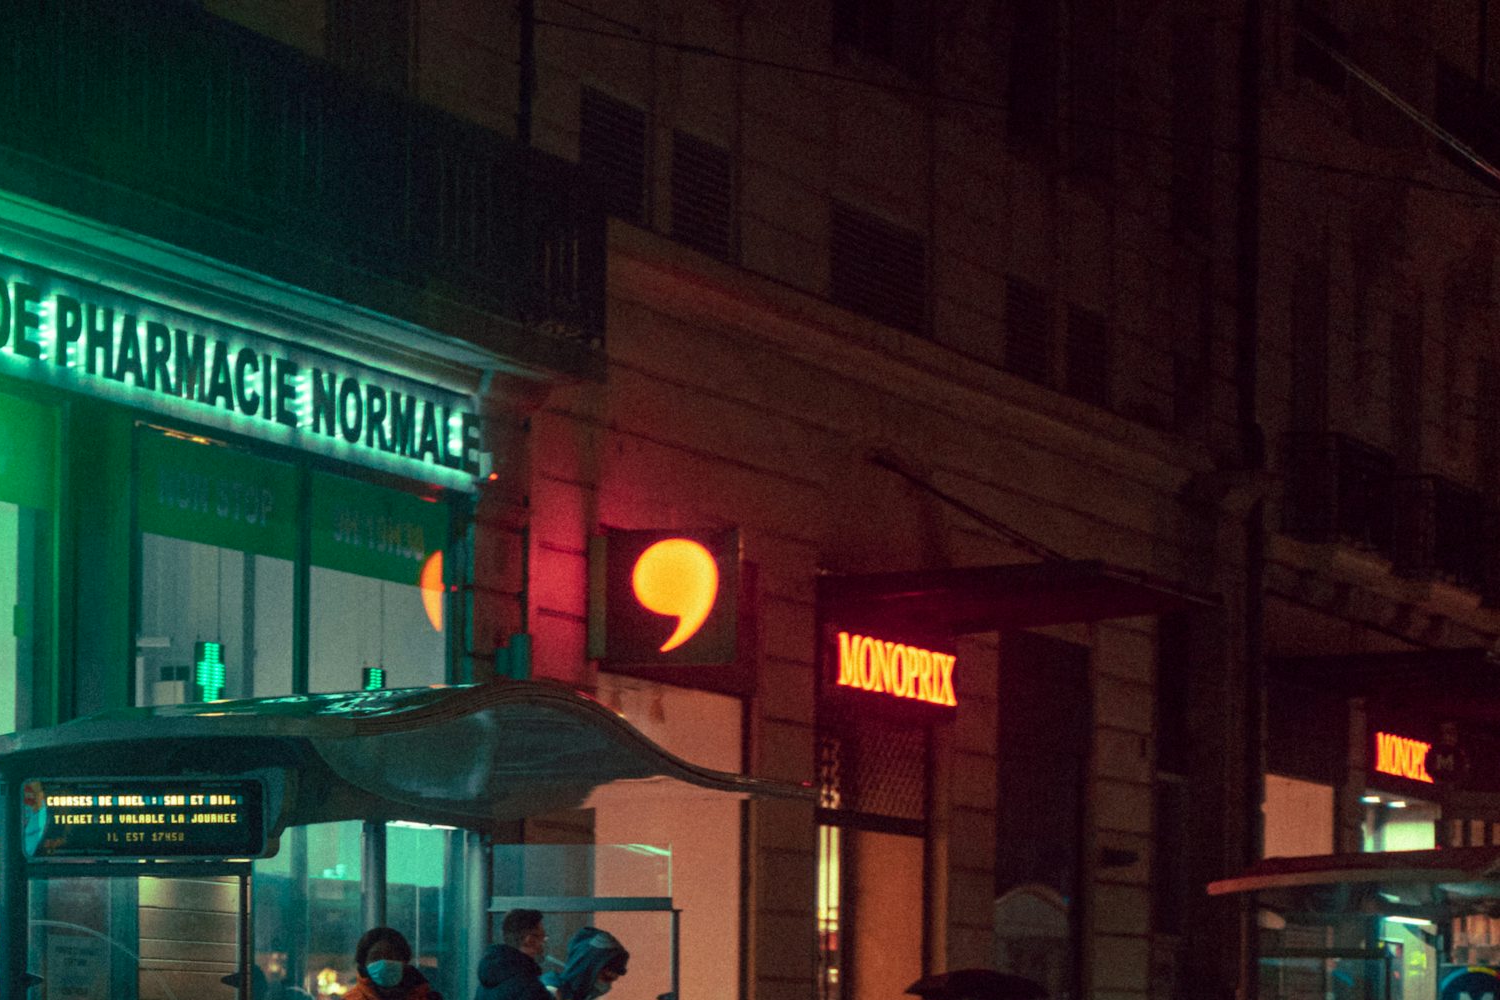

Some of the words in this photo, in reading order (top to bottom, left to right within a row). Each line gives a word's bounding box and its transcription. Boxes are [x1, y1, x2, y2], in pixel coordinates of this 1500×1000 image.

[55, 293, 299, 428] PHARMACIE
[311, 367, 484, 477] NORMALE
[837, 631, 958, 707] MONOPRIX
[47, 795, 93, 806] COURSES
[98, 795, 113, 806] DE
[118, 795, 145, 806] NOEL
[190, 795, 204, 806] ET
[54, 813, 93, 824] TICKET
[99, 813, 113, 824] 1H
[118, 813, 165, 824] VALABLE
[171, 813, 185, 824] LA
[191, 813, 237, 824] JOURNEE
[107, 832, 119, 842] IL
[125, 832, 145, 842] EST
